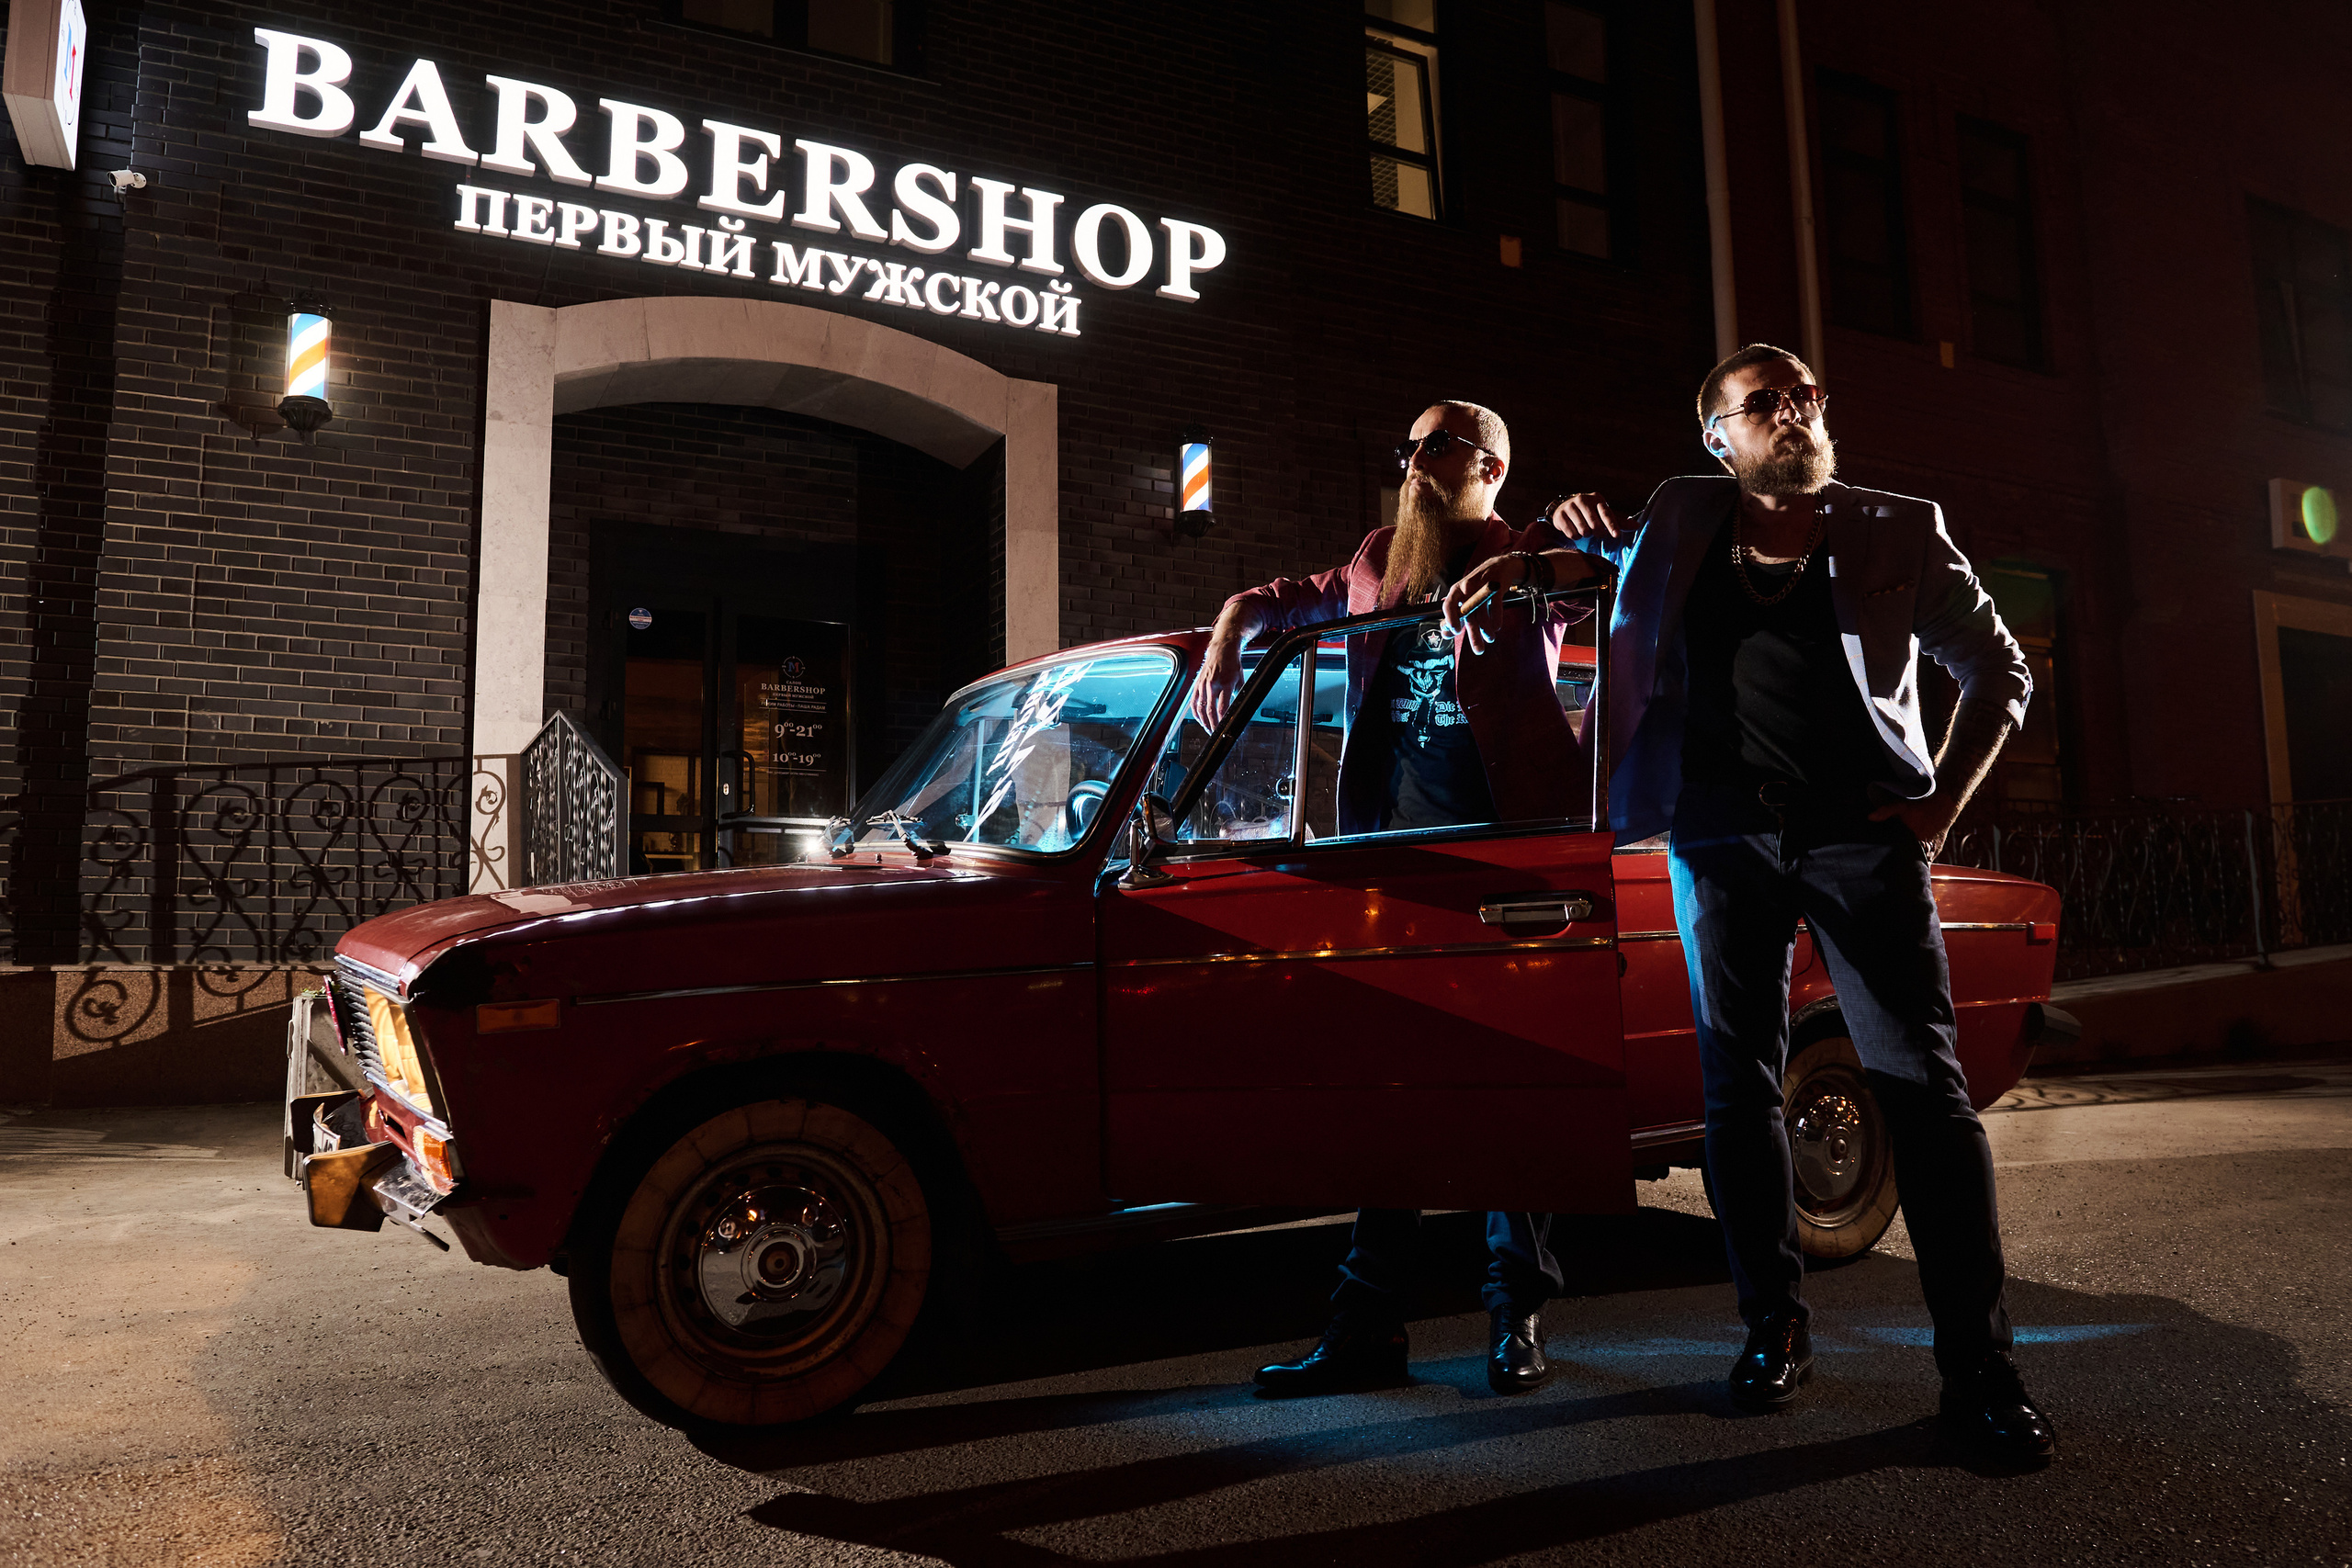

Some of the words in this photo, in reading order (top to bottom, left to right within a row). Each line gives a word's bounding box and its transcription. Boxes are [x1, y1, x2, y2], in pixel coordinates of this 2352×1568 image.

[247, 27, 1227, 300] BARBERSHOP
[454, 184, 757, 279] ПЕРВЫЙ
[769, 241, 1082, 337] МУЖСКОЙ
[761, 682, 826, 695] BARBERSHOP
[1434, 701, 1455, 714] Die
[1434, 714, 1455, 727] The
